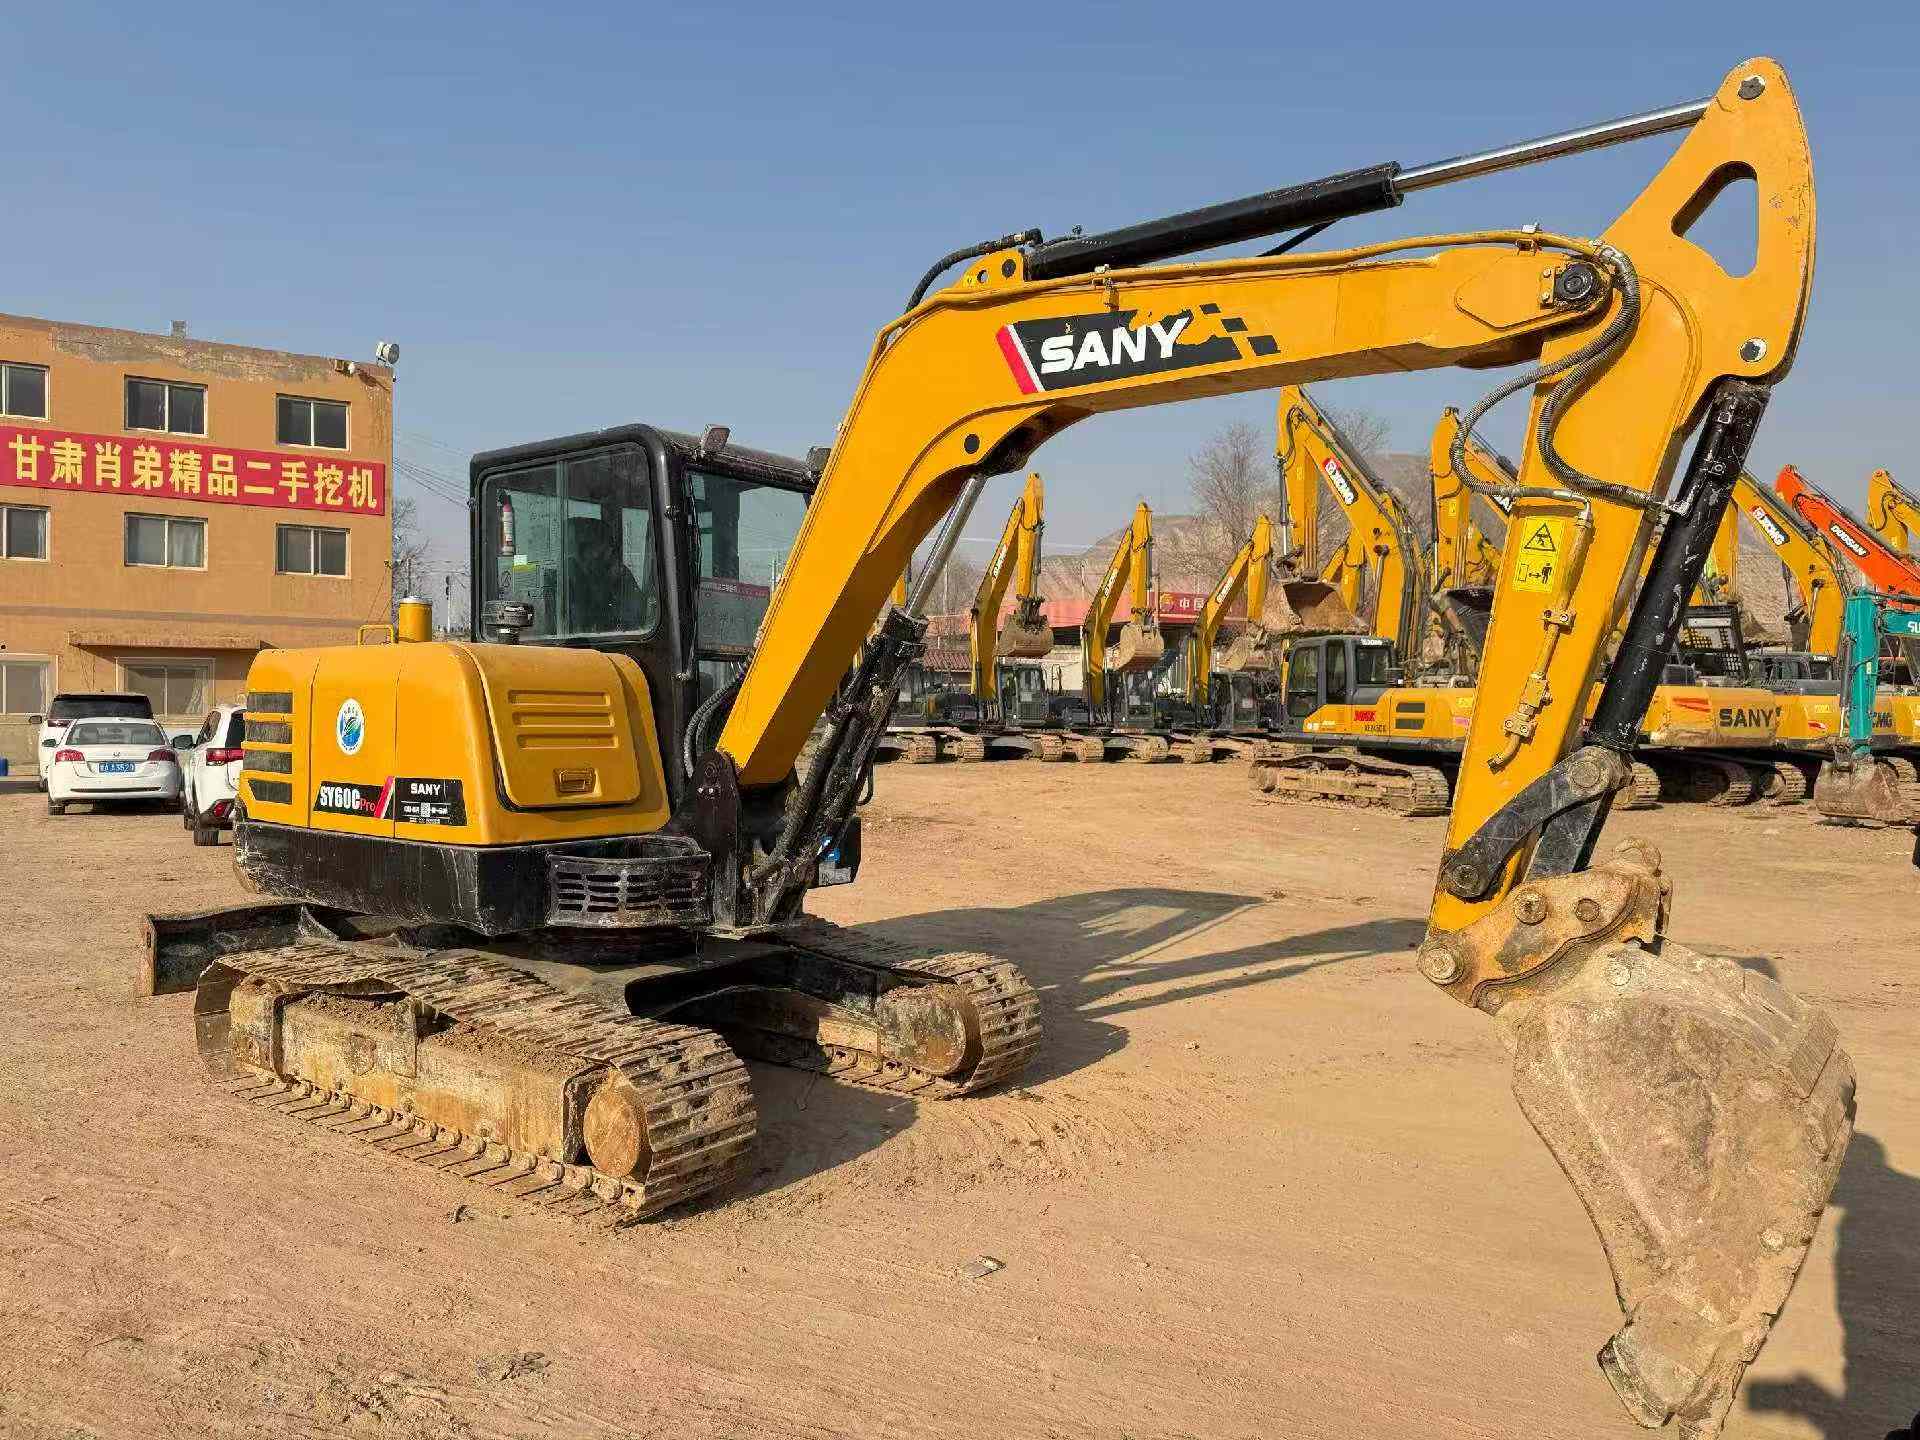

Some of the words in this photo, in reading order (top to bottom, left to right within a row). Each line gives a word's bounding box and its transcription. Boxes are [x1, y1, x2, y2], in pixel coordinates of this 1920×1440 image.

[1040, 317, 1190, 374] SANY
[8, 433, 376, 509] 甘肃肖弟精品二手挖机
[1719, 708, 1774, 728] SANY
[410, 782, 441, 796] SANY
